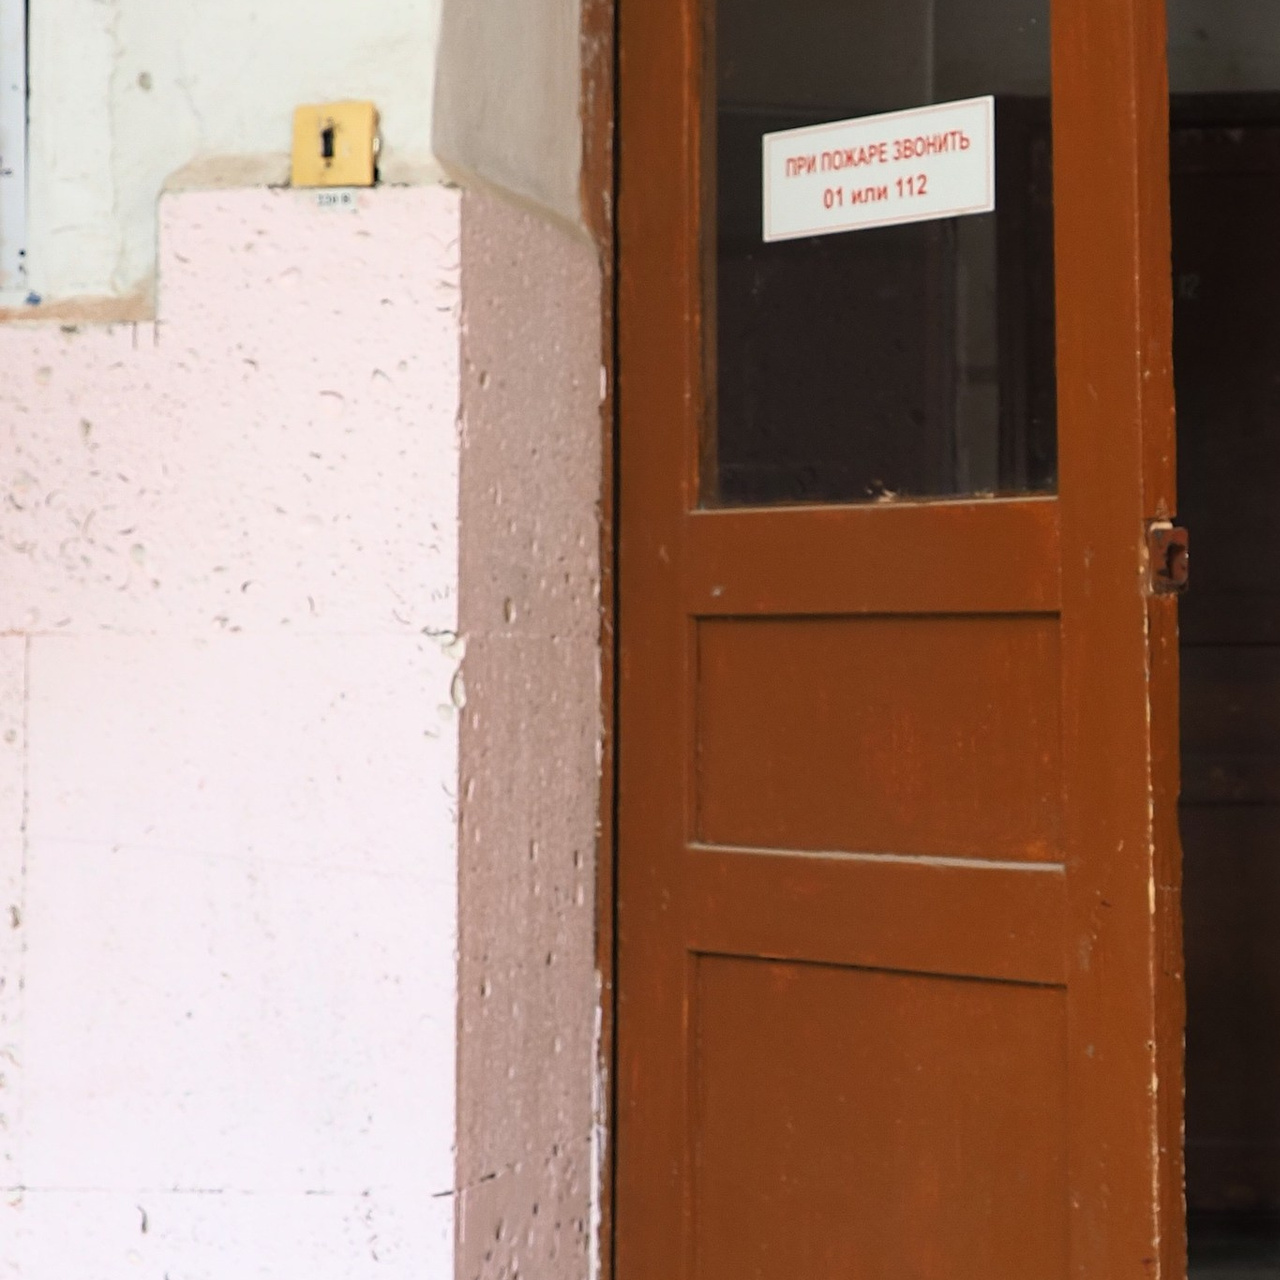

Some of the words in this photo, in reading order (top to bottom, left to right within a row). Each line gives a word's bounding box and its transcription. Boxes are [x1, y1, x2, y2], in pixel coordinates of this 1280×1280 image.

[786, 155, 816, 176] ПРИ
[821, 142, 888, 171] ПОЖАРЕ
[893, 130, 970, 161] ЗВОНИТЬ
[823, 187, 843, 210] 01
[851, 186, 888, 205] или
[896, 174, 927, 197] 112
